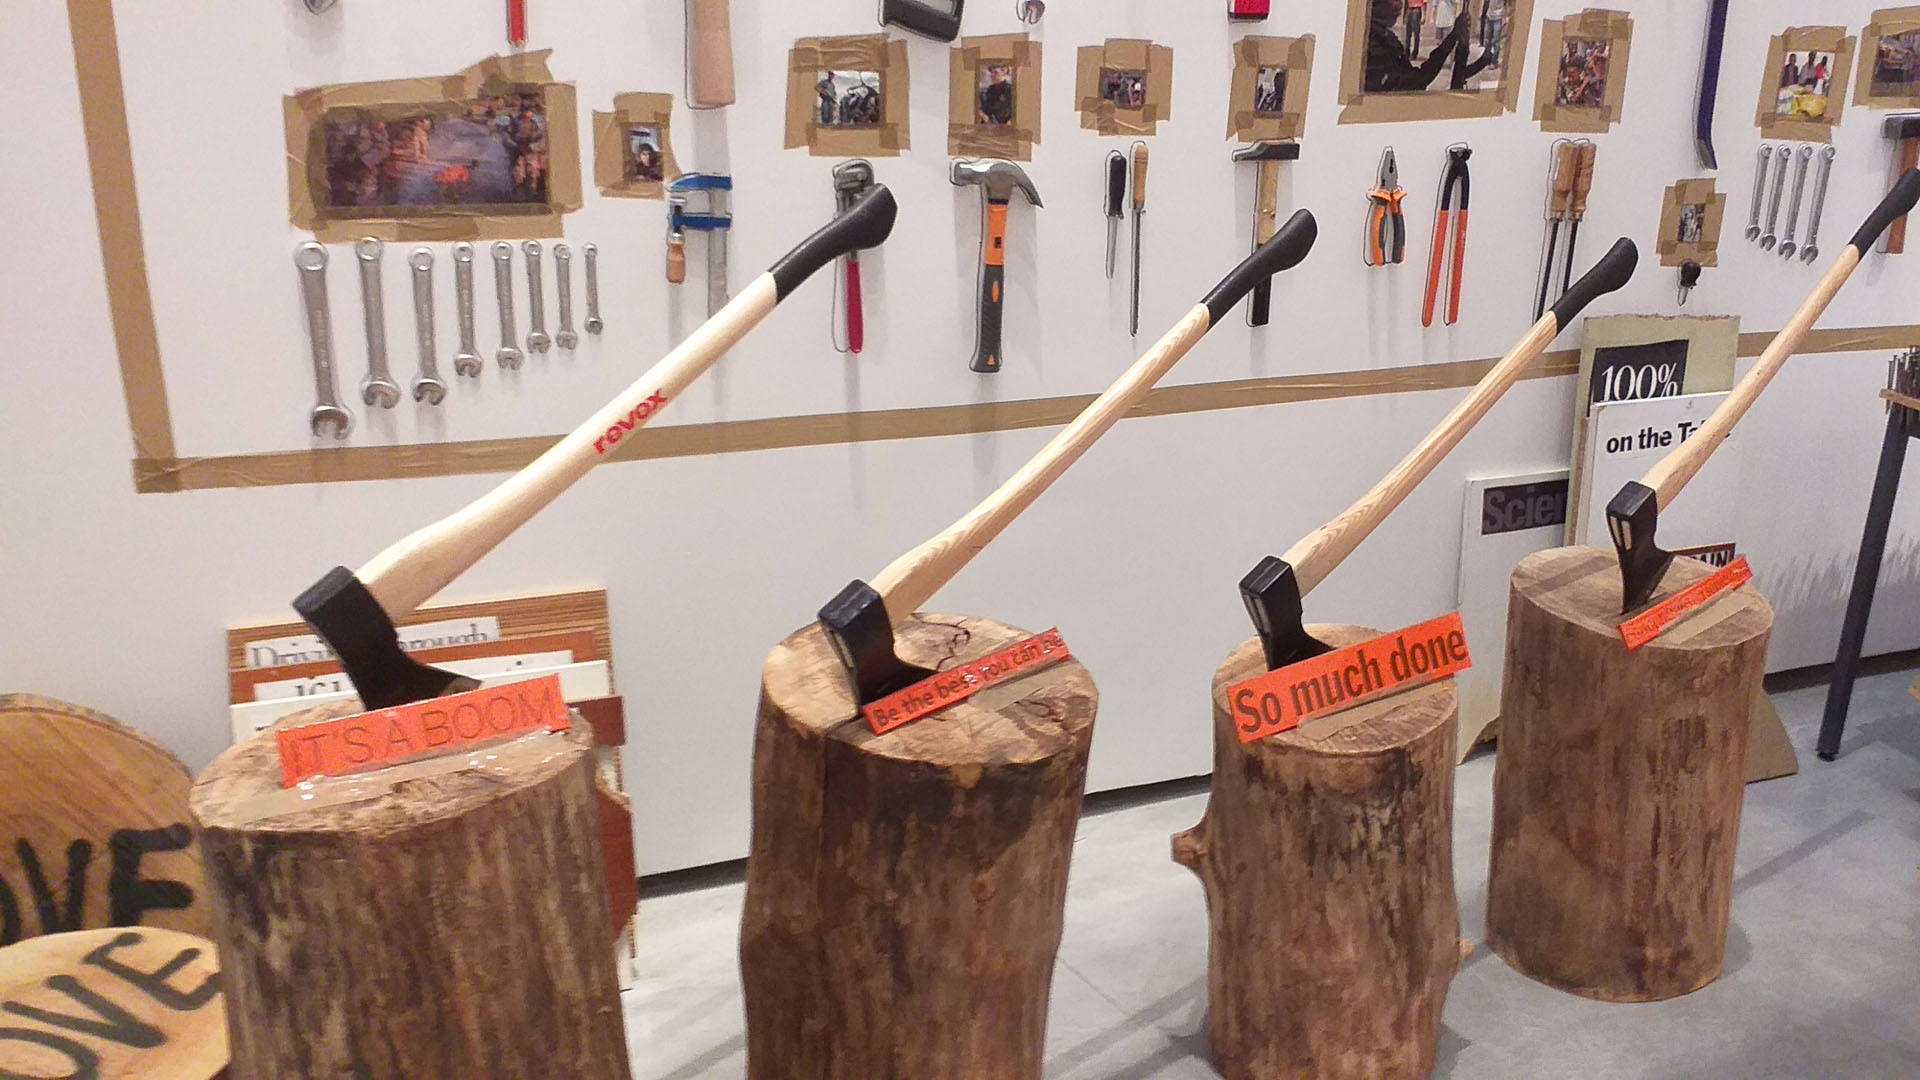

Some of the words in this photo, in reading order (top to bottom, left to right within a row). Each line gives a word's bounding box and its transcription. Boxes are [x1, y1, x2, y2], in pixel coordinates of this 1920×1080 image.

[1601, 362, 1678, 402] 100%
[1606, 434, 1632, 454] on
[1638, 426, 1672, 450] the
[872, 707, 899, 728] Be
[901, 690, 934, 715] the
[1012, 644, 1041, 666] can
[1235, 688, 1282, 733] So
[1290, 649, 1383, 717] much
[1390, 630, 1468, 682] done
[385, 719, 411, 757] A
[420, 686, 559, 747] BOOM
